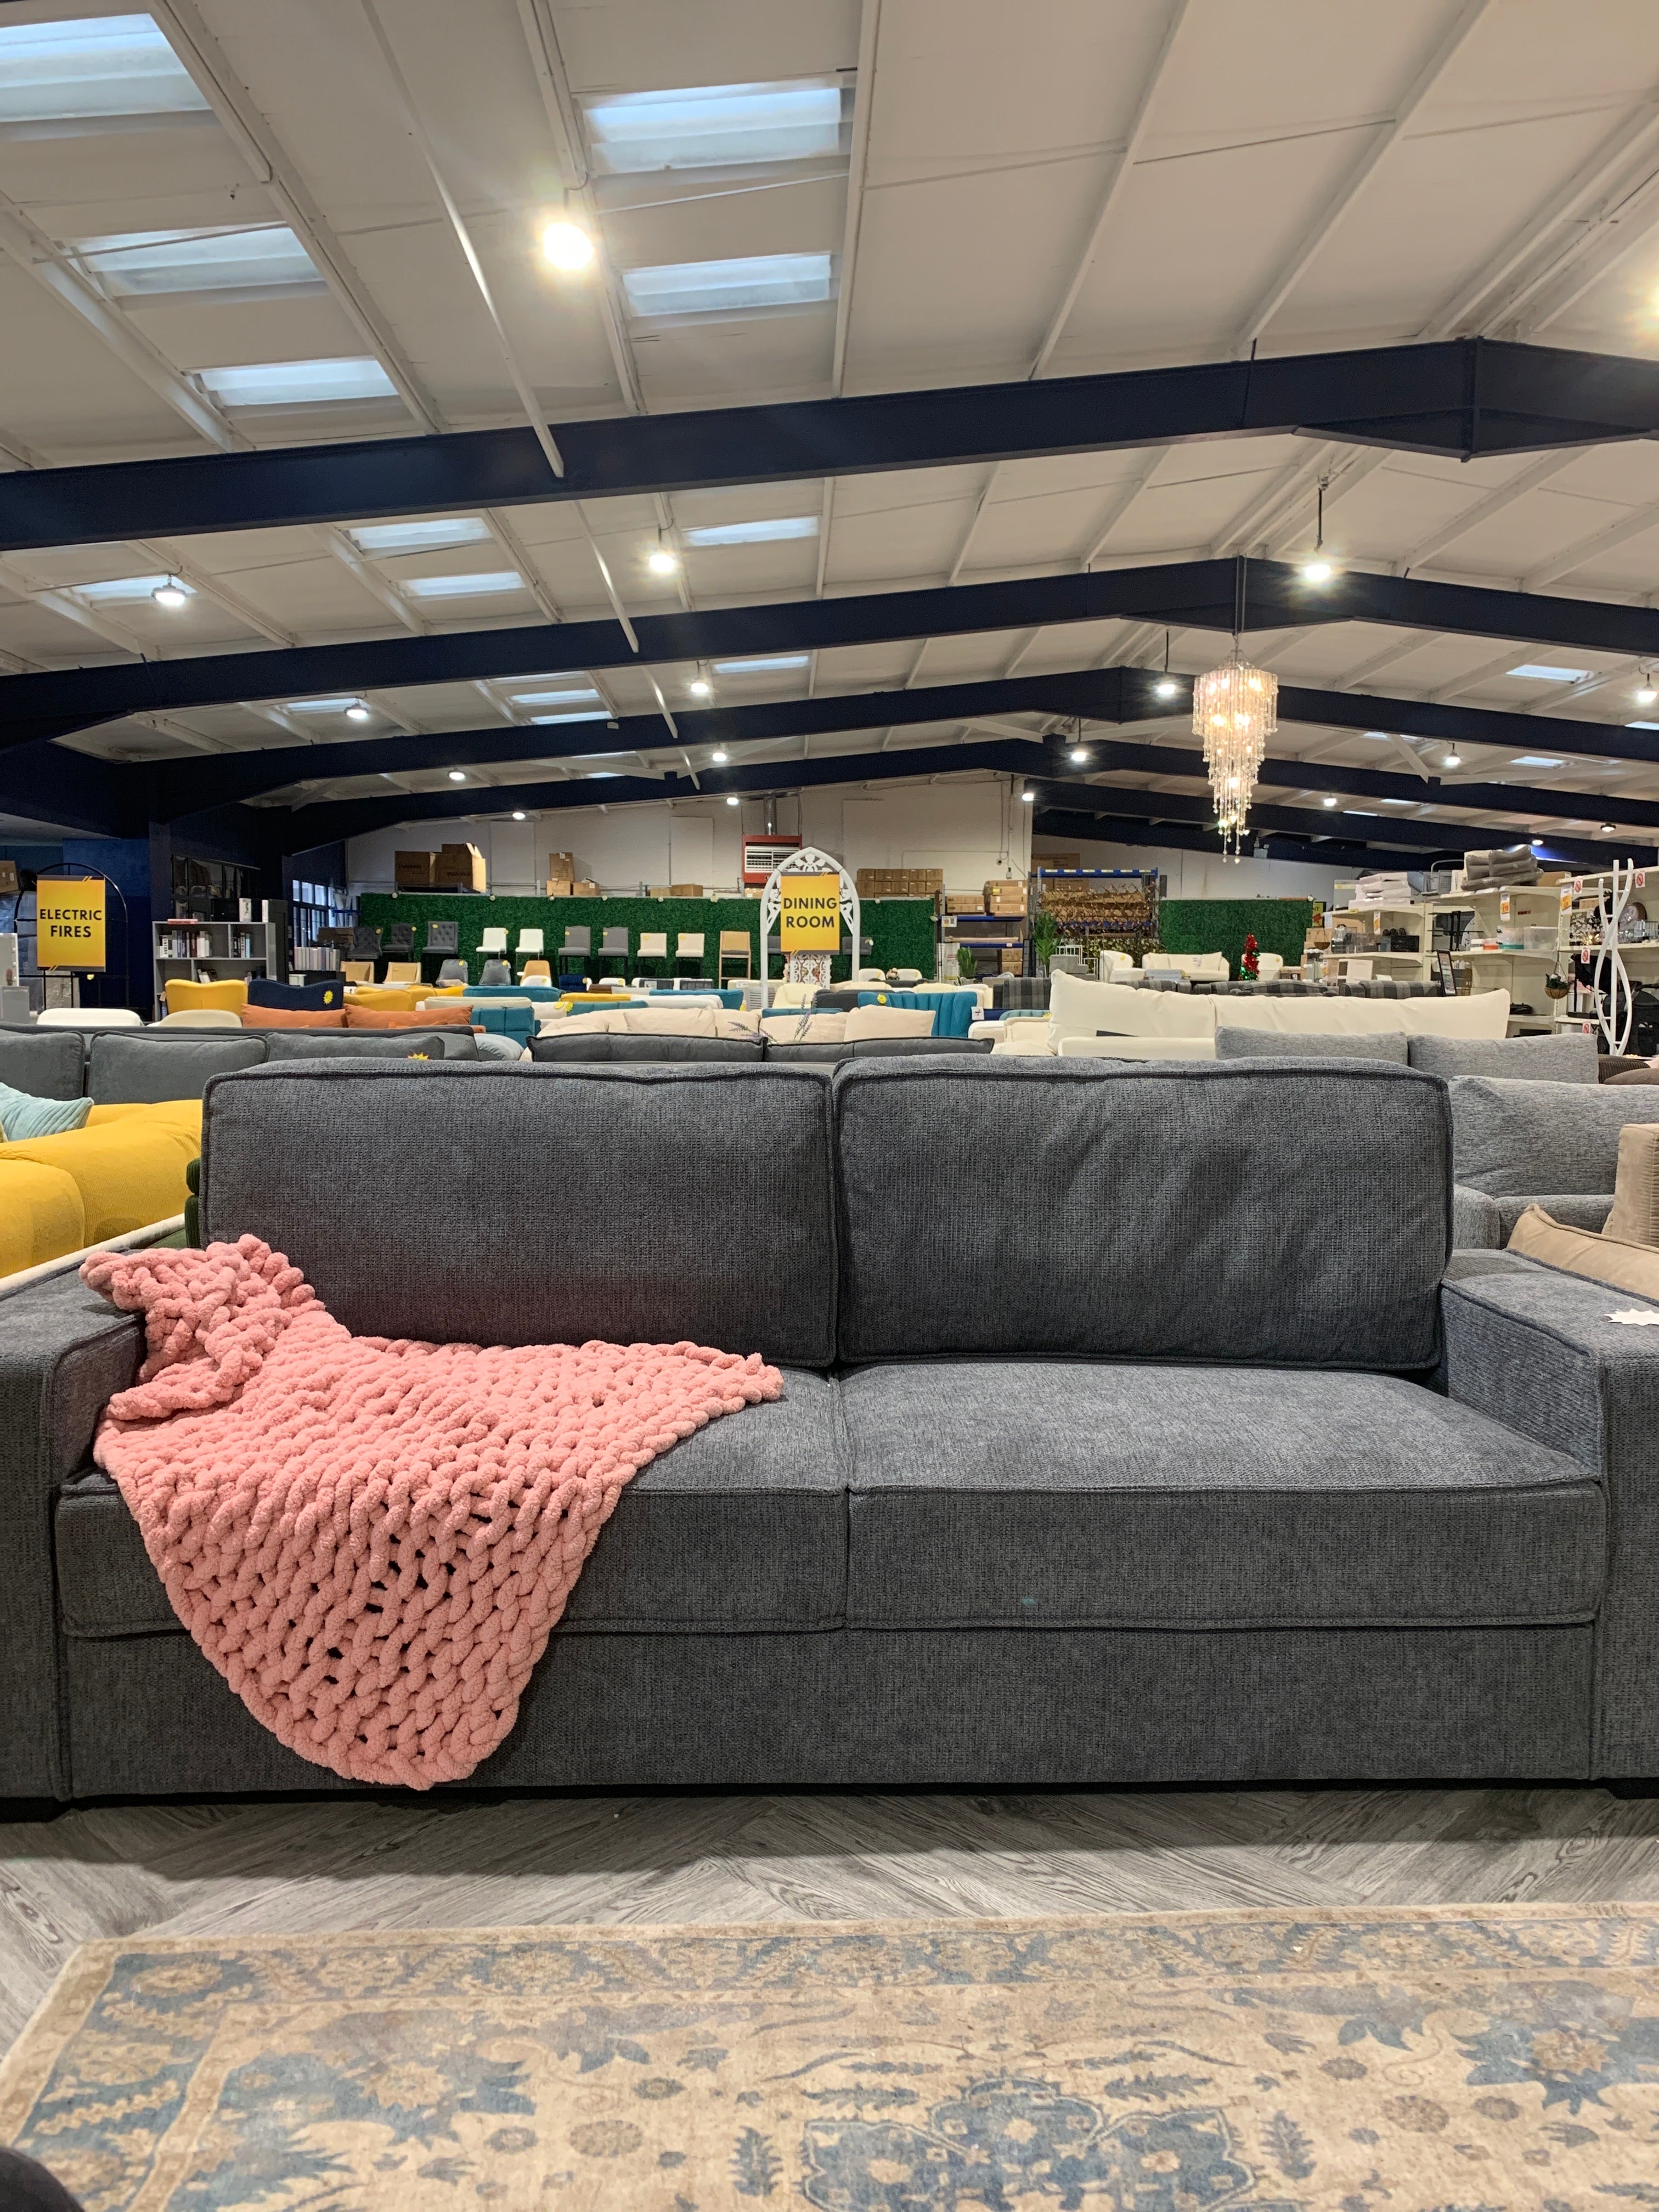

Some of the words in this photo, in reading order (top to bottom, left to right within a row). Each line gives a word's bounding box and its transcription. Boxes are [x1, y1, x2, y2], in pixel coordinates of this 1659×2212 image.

[783, 898, 837, 909] DINING
[40, 909, 101, 921] ELECTRIC
[786, 916, 834, 928] ROOM
[50, 926, 91, 938] FIRES
